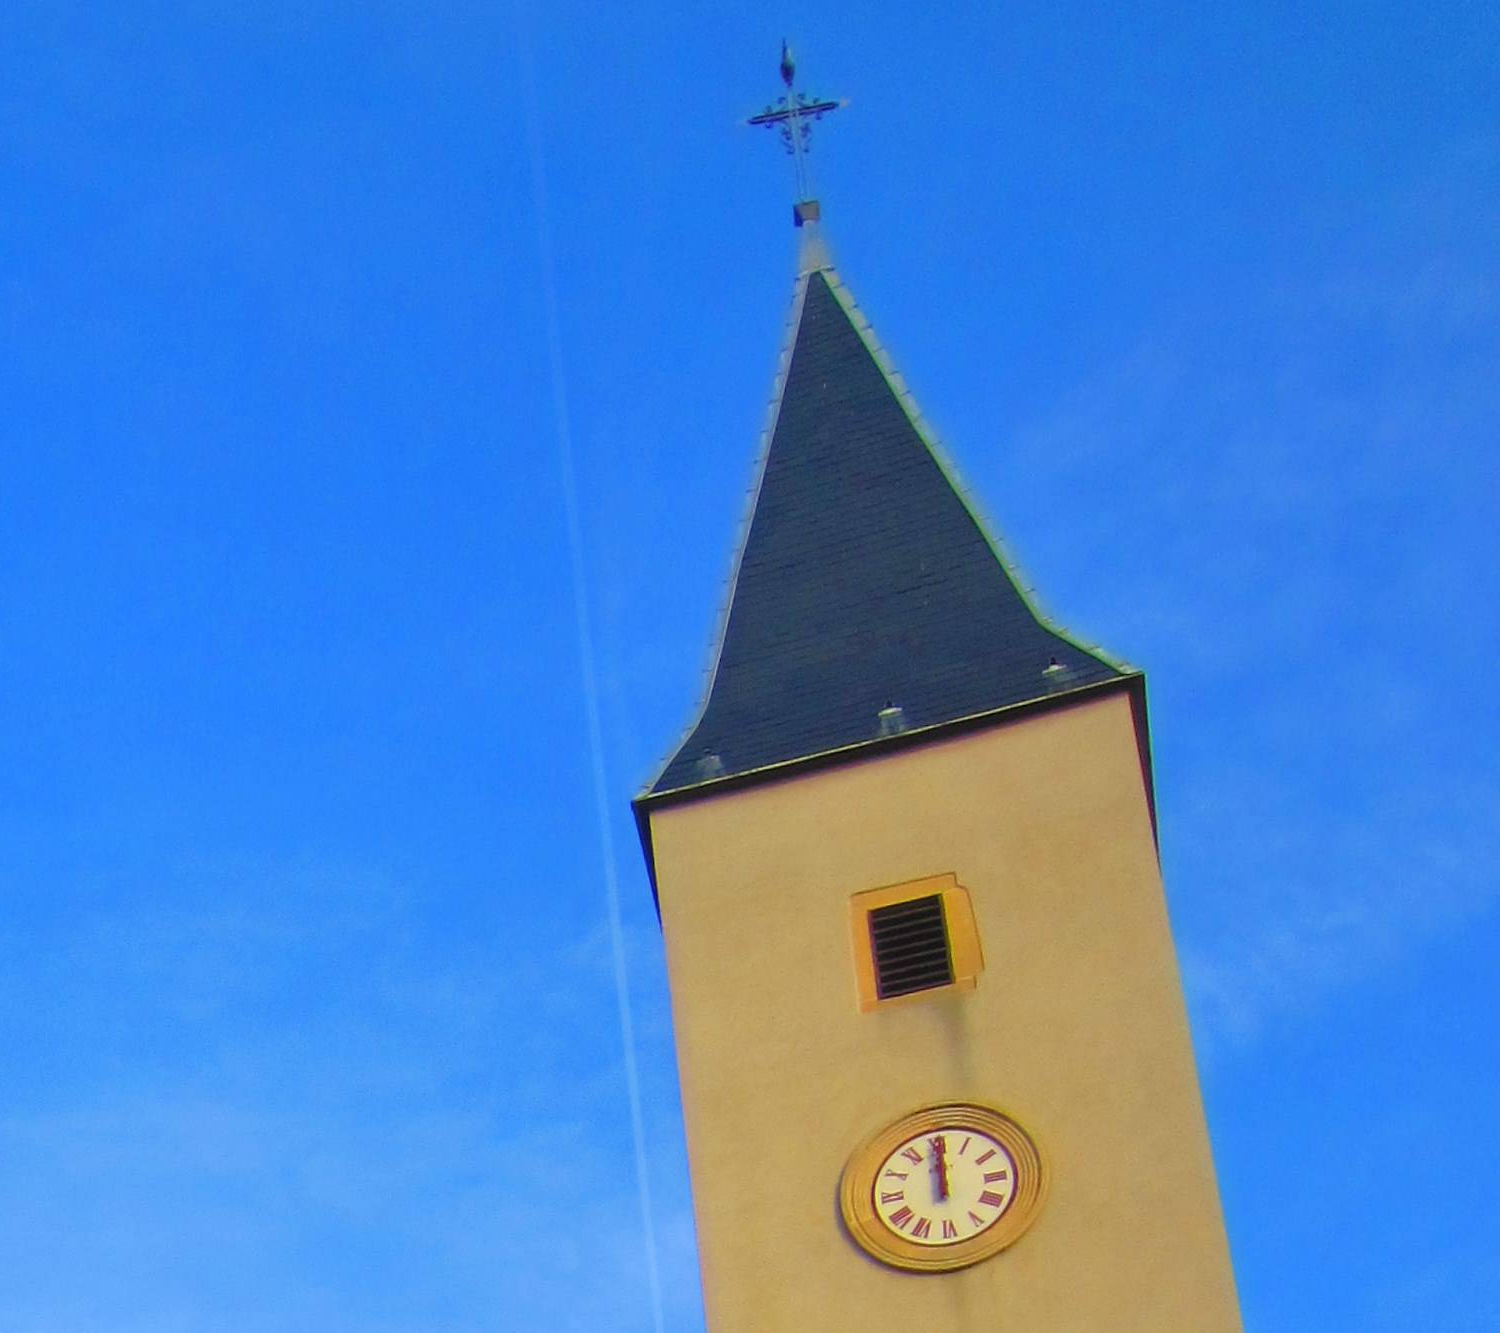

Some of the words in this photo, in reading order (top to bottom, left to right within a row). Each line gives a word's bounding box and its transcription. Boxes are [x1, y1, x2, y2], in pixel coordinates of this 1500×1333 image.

[959, 1136, 971, 1155] I
[901, 1147, 924, 1166] XI
[975, 1149, 997, 1165] II
[884, 1169, 908, 1181] X
[983, 1170, 1007, 1184] III
[881, 1190, 904, 1205] IX
[888, 1205, 915, 1230] VIII
[967, 1210, 985, 1227] V
[911, 1217, 931, 1239] VII
[942, 1219, 958, 1239] VI
